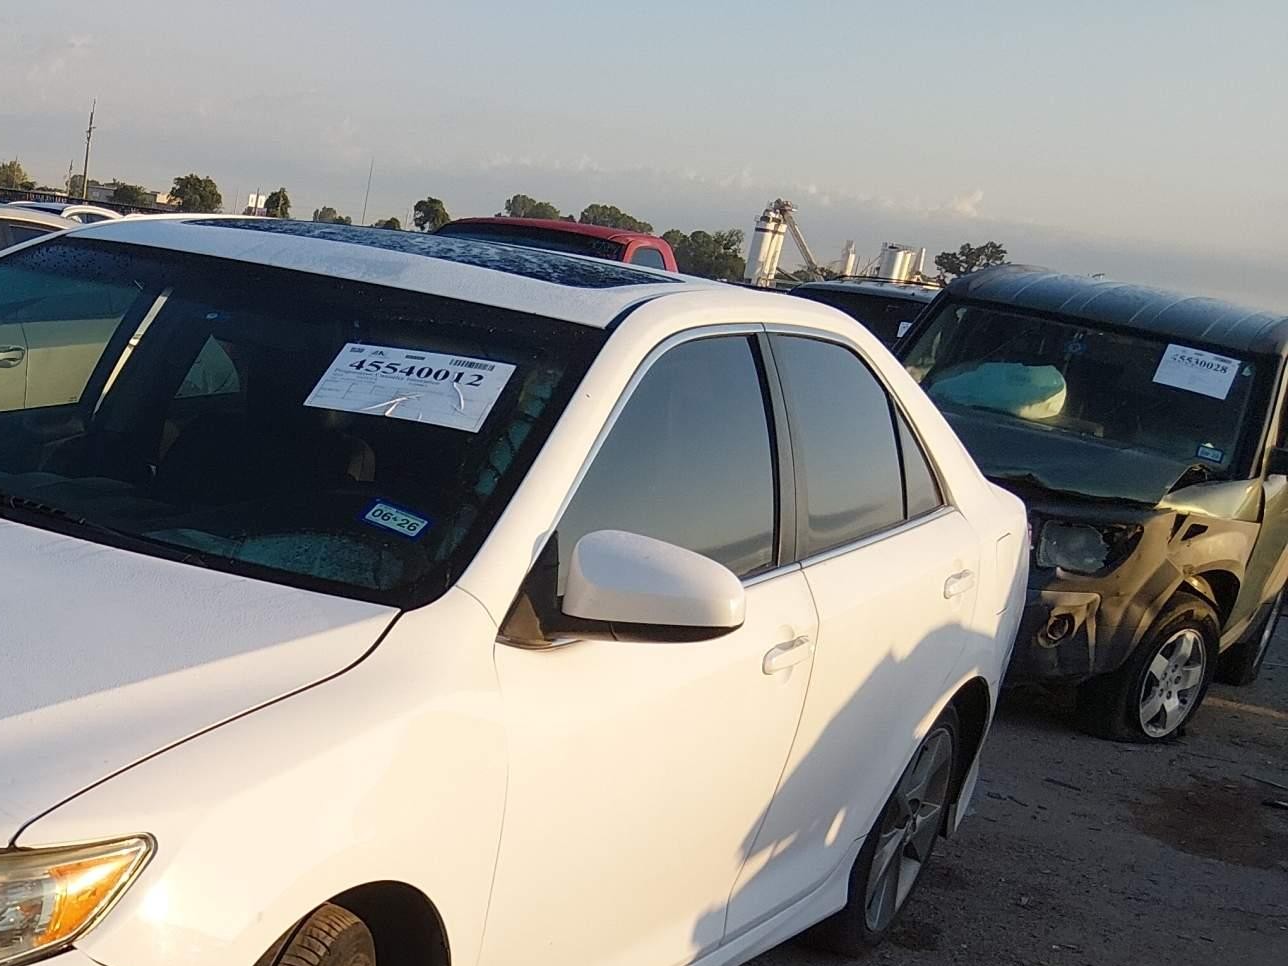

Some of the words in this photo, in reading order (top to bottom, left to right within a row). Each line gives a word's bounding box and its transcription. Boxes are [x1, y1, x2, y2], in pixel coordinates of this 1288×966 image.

[349, 358, 484, 387] 45540012
[372, 509, 394, 521] 06
[396, 519, 420, 531] 26
